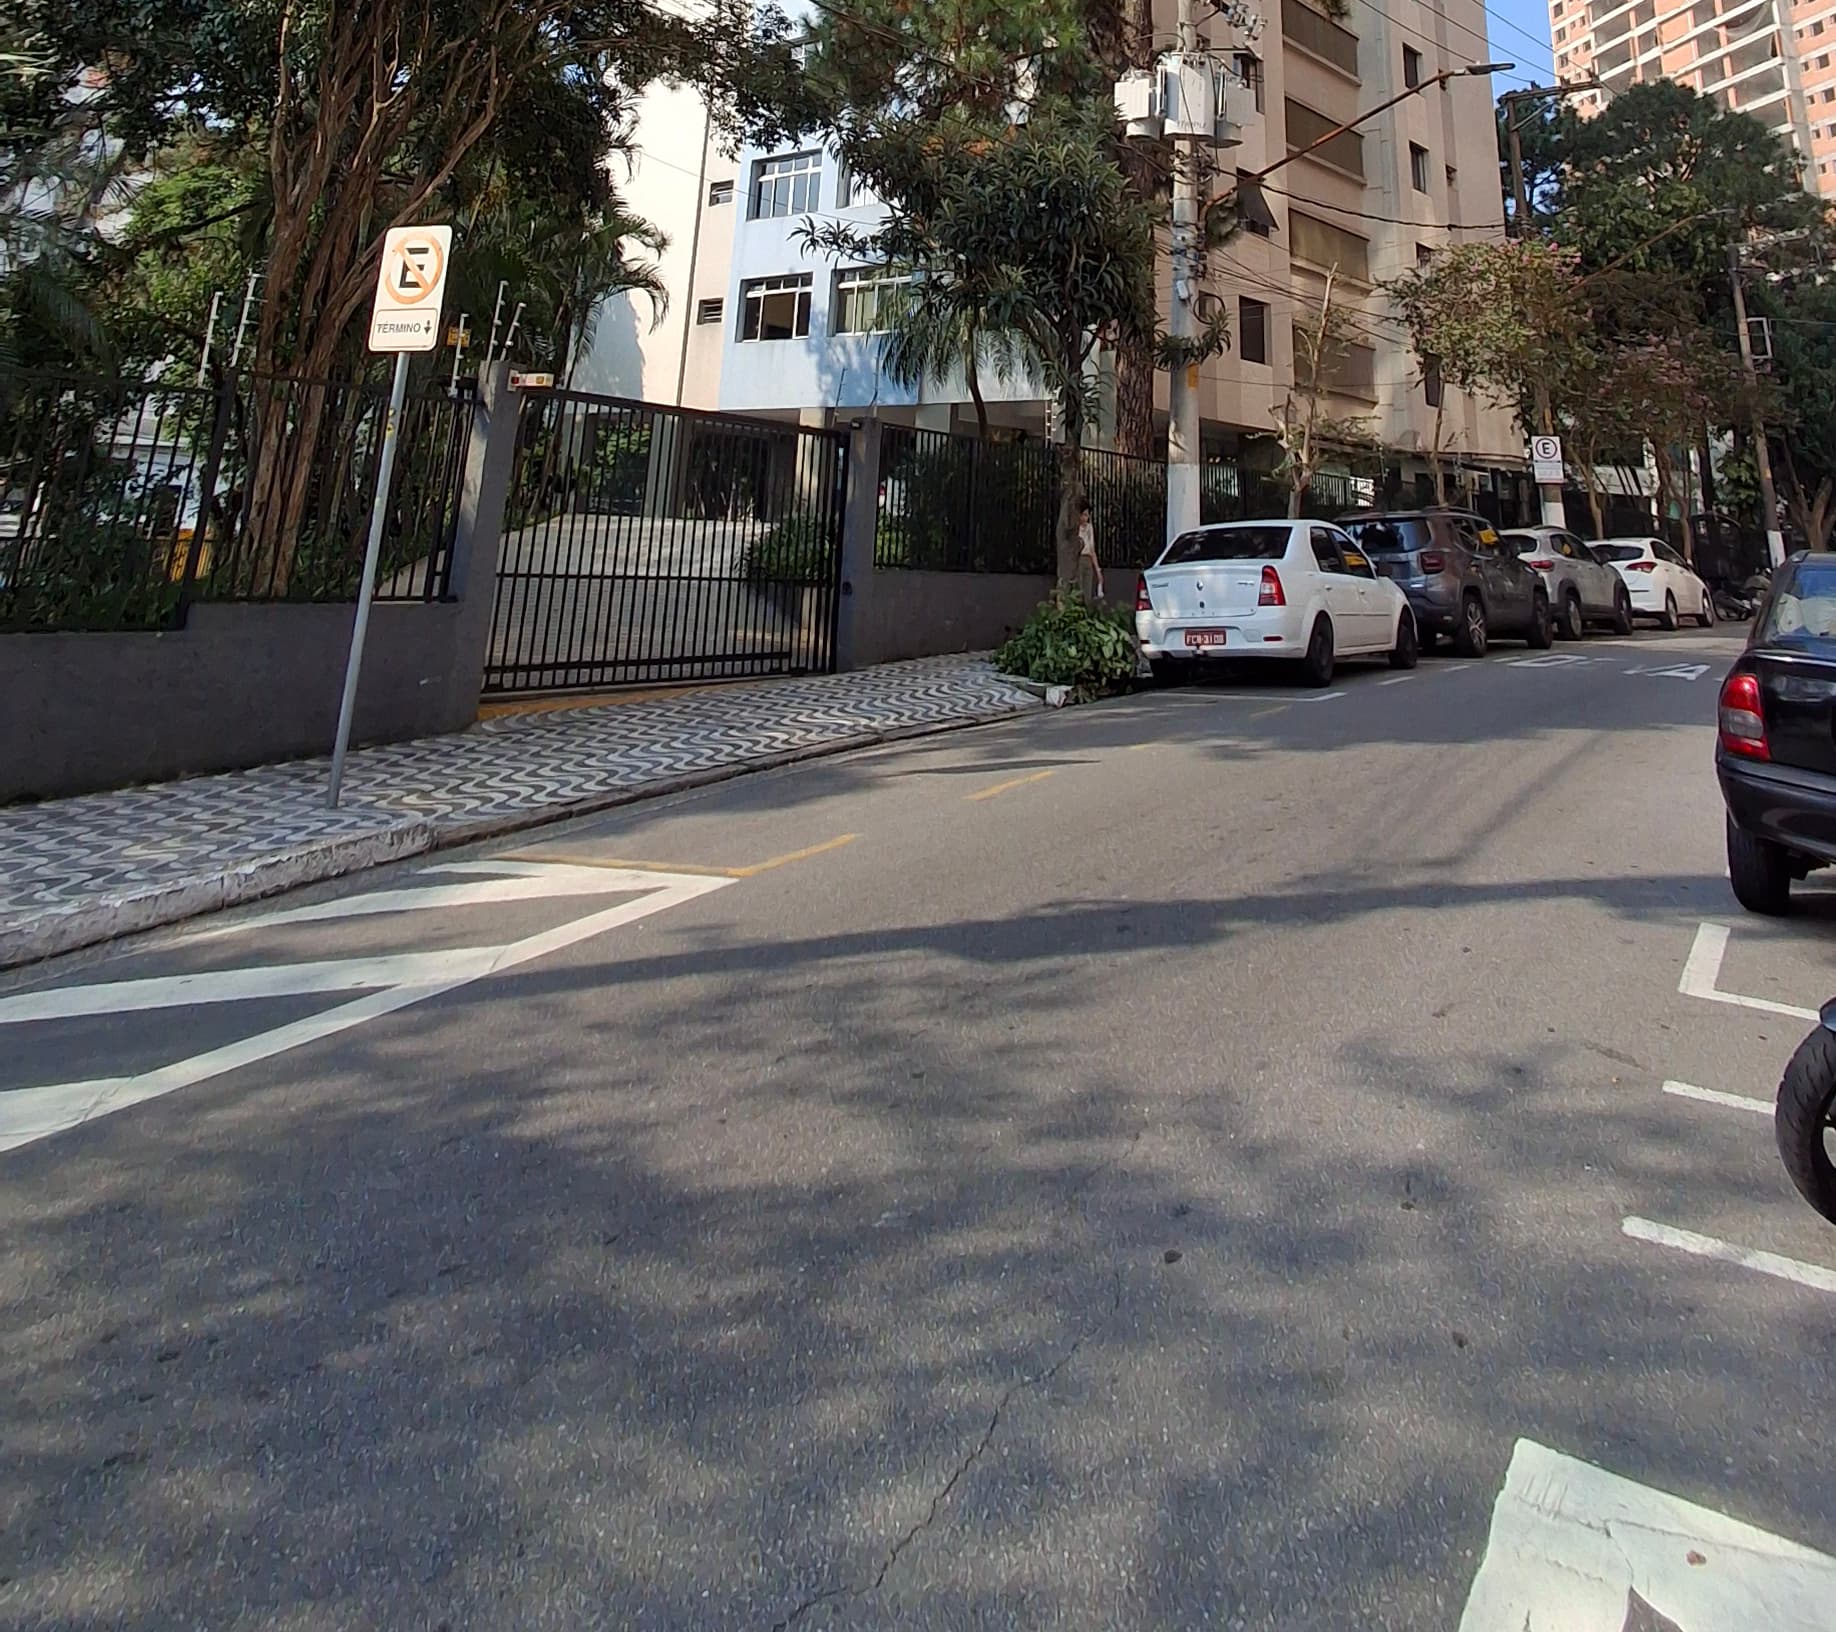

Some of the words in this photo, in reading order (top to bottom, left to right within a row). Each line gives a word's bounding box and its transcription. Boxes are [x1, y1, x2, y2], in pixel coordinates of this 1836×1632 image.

[398, 247, 430, 288] E
[376, 319, 422, 334] TÉRMINO
[1541, 442, 1552, 455] E
